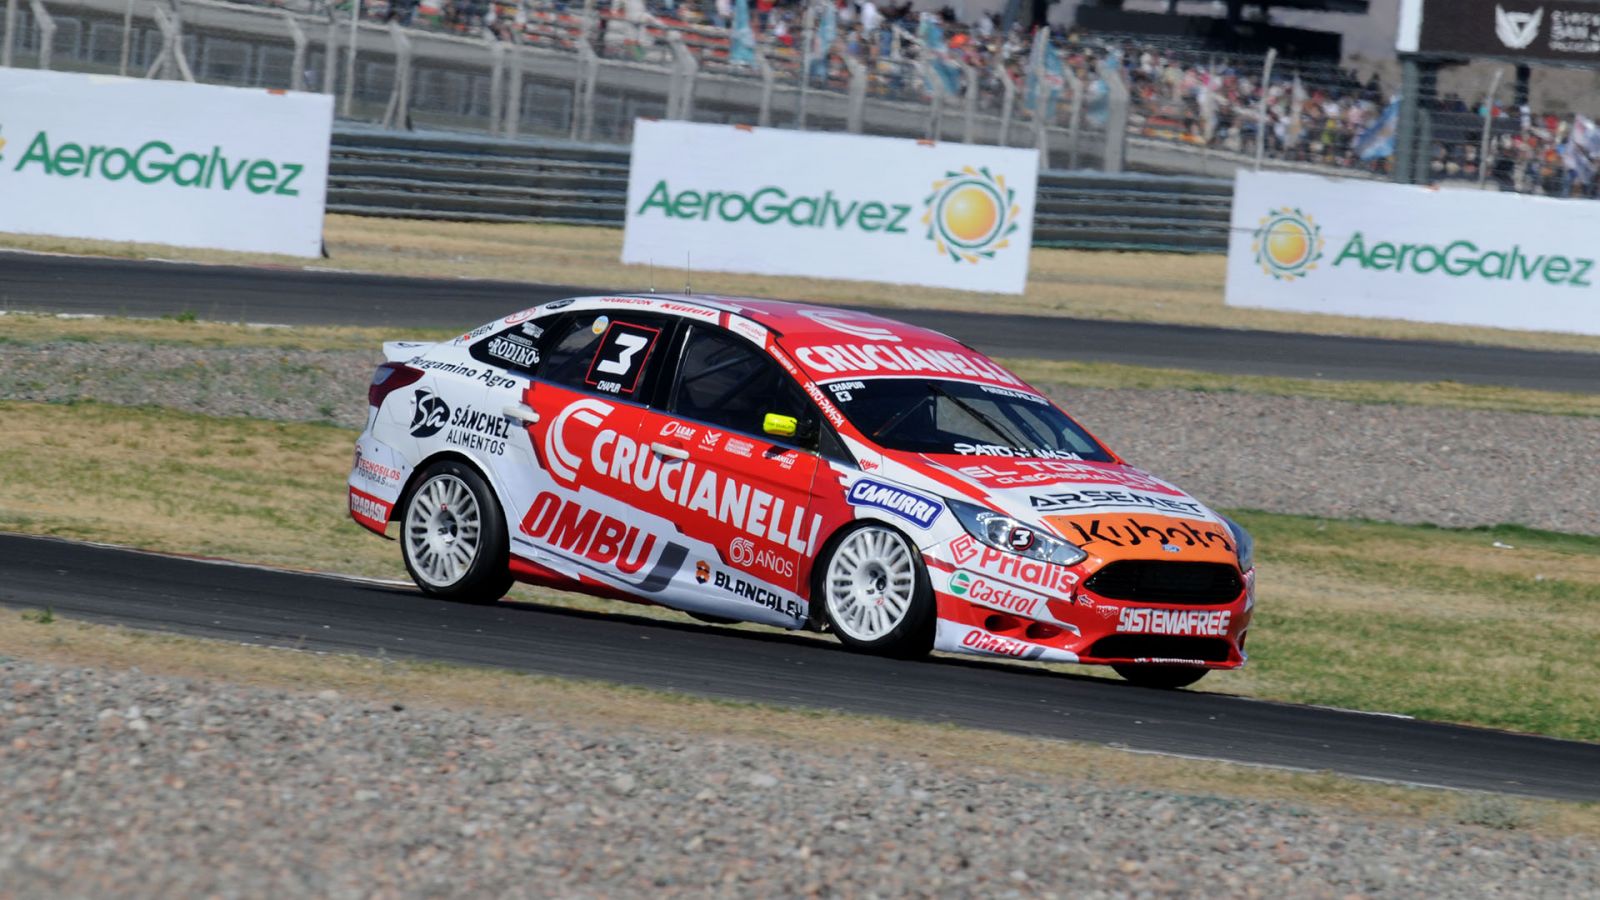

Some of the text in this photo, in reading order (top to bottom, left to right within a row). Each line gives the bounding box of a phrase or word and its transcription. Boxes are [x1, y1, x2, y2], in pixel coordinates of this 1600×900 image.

[15, 130, 305, 197] AeroGalvez
[637, 179, 912, 237] AeroGalvez
[1333, 231, 1595, 288] AeroGalvez
[405, 355, 517, 388] Pergamino Agro
[597, 332, 648, 375] 3
[795, 344, 1023, 386] CRUCIANELLI
[451, 404, 512, 439] SÁNCHEZ
[446, 429, 506, 456] ALIMENTOS
[359, 458, 401, 481] TECNOSILOS
[958, 465, 1018, 480] EL
[591, 429, 823, 558] CRUCIANELLI
[852, 483, 937, 523] CAMURRI
[1029, 490, 1200, 514] ARSEMET
[519, 491, 657, 574] OMBU
[1012, 529, 1031, 546] 3
[1069, 518, 1232, 552] Kubota
[729, 537, 794, 578] 65 AÑOS
[979, 547, 1075, 595] Prialis
[714, 570, 803, 620] BLANCALEY
[969, 579, 1038, 616] Castrol
[1116, 606, 1232, 636] SISTEMAFREE
[962, 630, 1029, 657] OMBU
